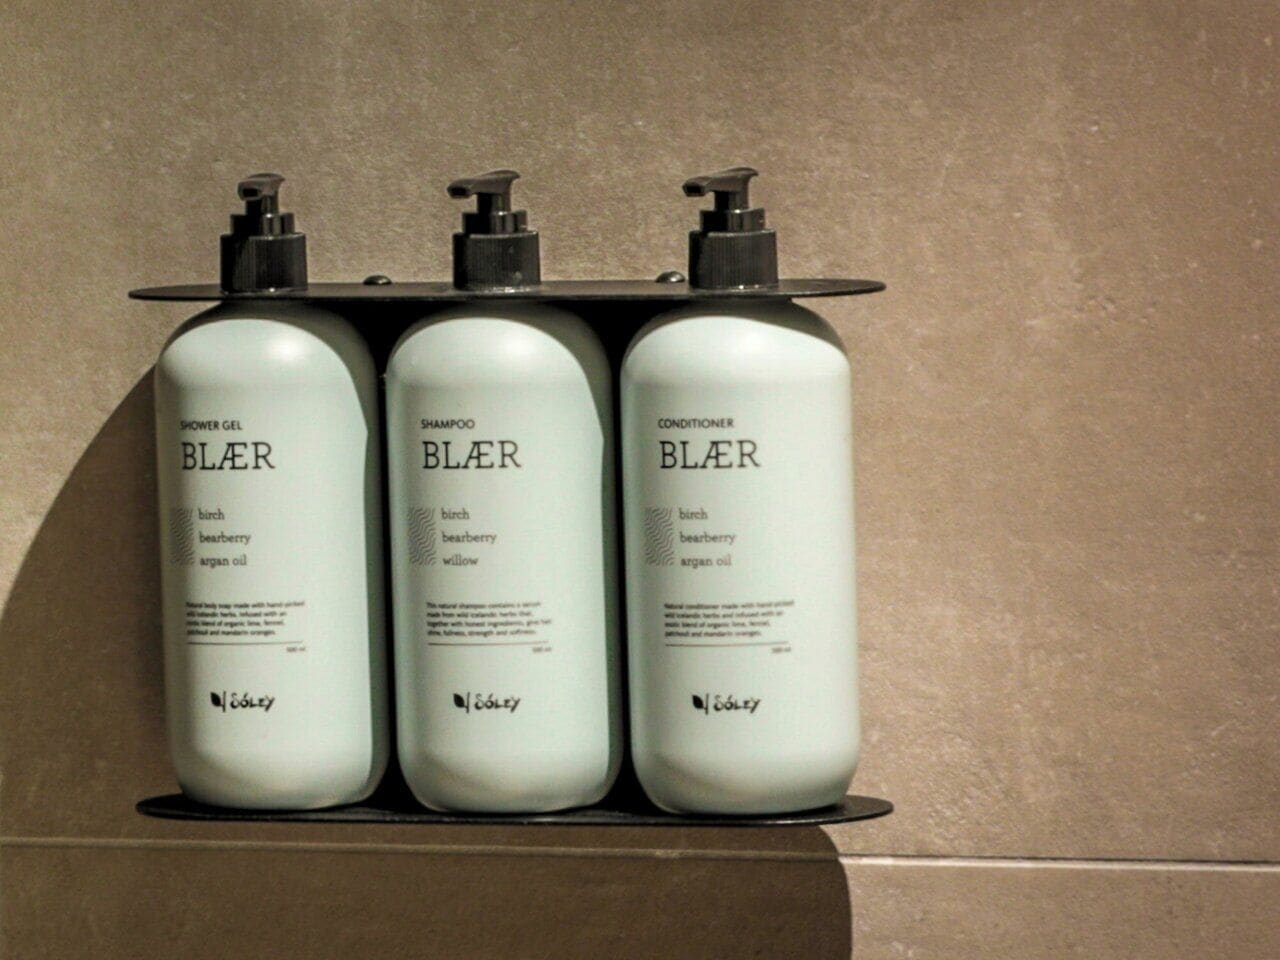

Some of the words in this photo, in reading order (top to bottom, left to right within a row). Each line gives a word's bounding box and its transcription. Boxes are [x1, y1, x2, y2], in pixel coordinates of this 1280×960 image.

[180, 421, 219, 431] SHOWER
[223, 421, 242, 430] GEL
[421, 419, 475, 429] SHAMPOO
[658, 419, 734, 428] CONDITIONER
[182, 442, 275, 470] BLÆR
[423, 441, 521, 469] BLÆR
[659, 441, 760, 469] BLÆR
[198, 509, 224, 520] birch
[442, 508, 470, 519] birch
[679, 509, 708, 520] birch
[199, 533, 250, 545] bearberry
[442, 532, 497, 545] bearberry
[680, 532, 736, 545] bearberry
[200, 557, 229, 568] argan
[233, 555, 247, 565] oil
[443, 555, 478, 565] willow
[681, 557, 712, 568] argan
[716, 555, 731, 566] oil
